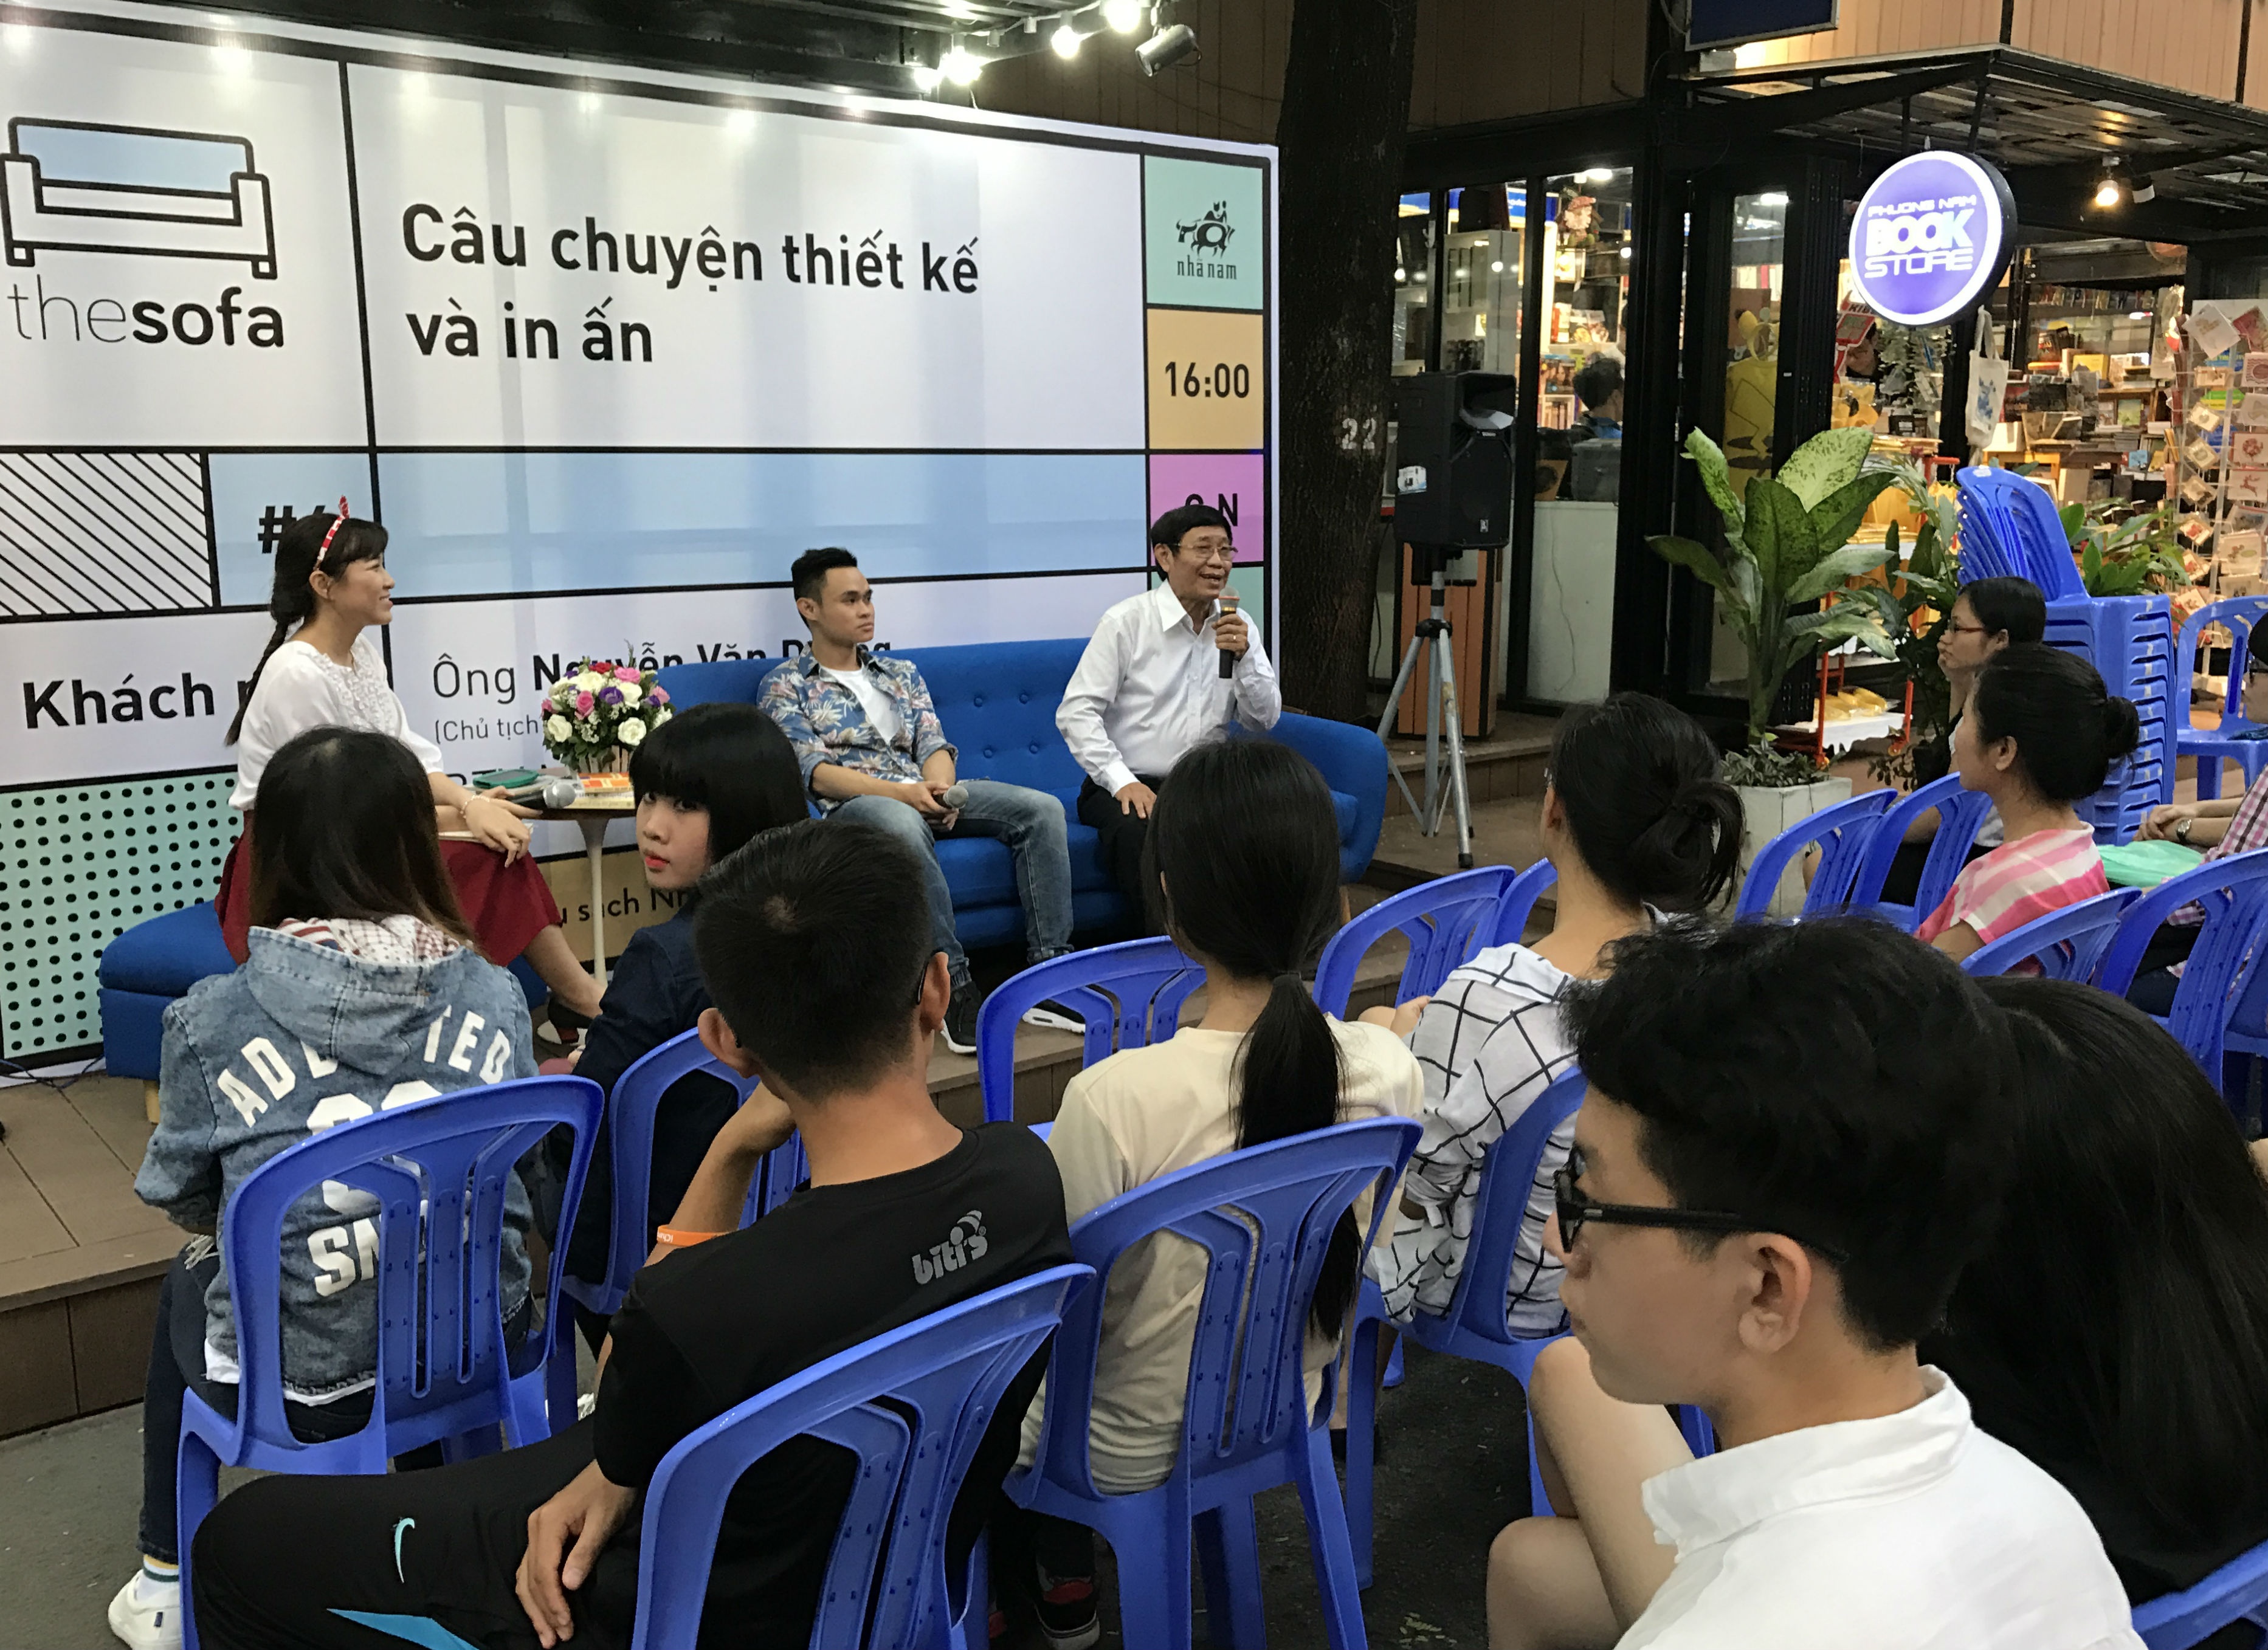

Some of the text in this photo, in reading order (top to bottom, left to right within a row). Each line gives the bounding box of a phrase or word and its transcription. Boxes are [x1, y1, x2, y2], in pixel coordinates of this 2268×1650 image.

[1938, 194, 1977, 209] NAM
[403, 204, 978, 294] Câu chuyện thiết kế
[1866, 208, 1975, 257] BOOK
[1207, 263, 1237, 280] nam
[1864, 248, 1974, 278] STORE
[7, 273, 284, 348] thesofa
[405, 296, 652, 363] và in ấn
[1165, 361, 1250, 399] 16:00
[1342, 418, 1377, 450] 22
[433, 653, 515, 704] Ông
[22, 672, 215, 729] Khách
[435, 713, 539, 745] (Chủ tịch
[578, 887, 640, 922] sch
